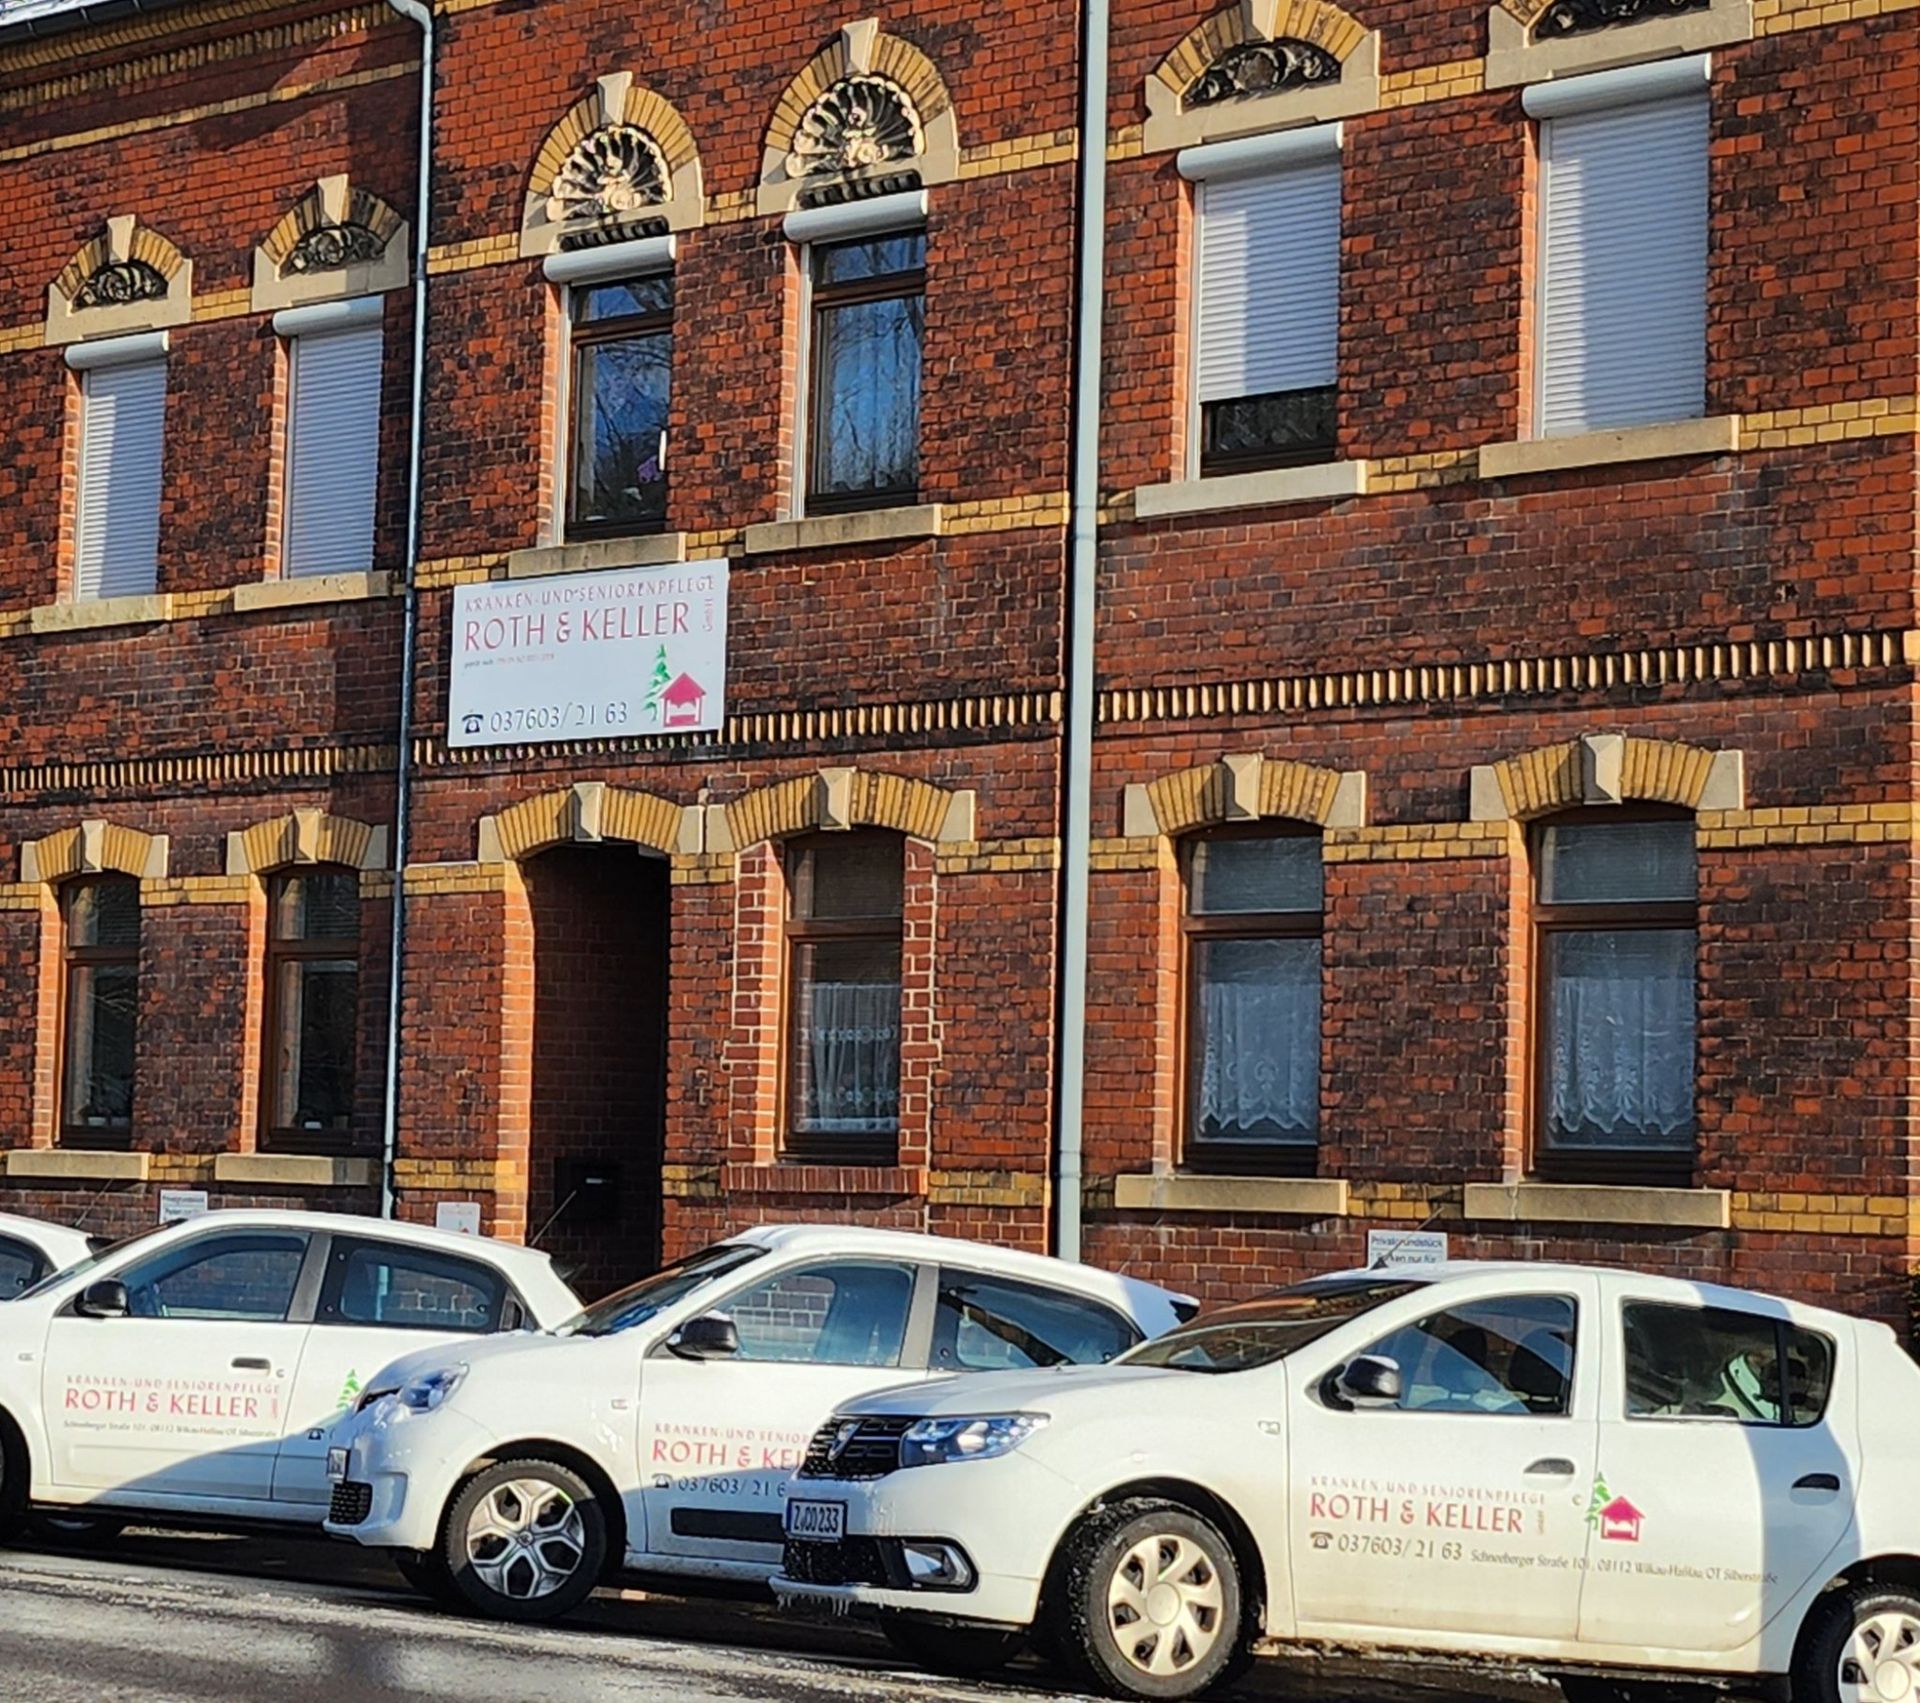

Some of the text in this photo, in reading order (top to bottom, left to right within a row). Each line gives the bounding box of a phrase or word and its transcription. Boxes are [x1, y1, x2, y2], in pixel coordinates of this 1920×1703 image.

[577, 575, 715, 601] SENIORENPFLEGE
[464, 613, 546, 651] ROTH
[556, 611, 572, 644] &
[581, 601, 690, 642] KELLER
[65, 1388, 137, 1413] ROTH
[145, 1392, 160, 1414] &
[169, 1393, 260, 1418] KELLER
[652, 1439, 727, 1467] ROTH
[737, 1445, 752, 1467] &
[1310, 1492, 1388, 1523] ROTH
[1400, 1500, 1414, 1525] &
[1426, 1501, 1524, 1534] KELLER
